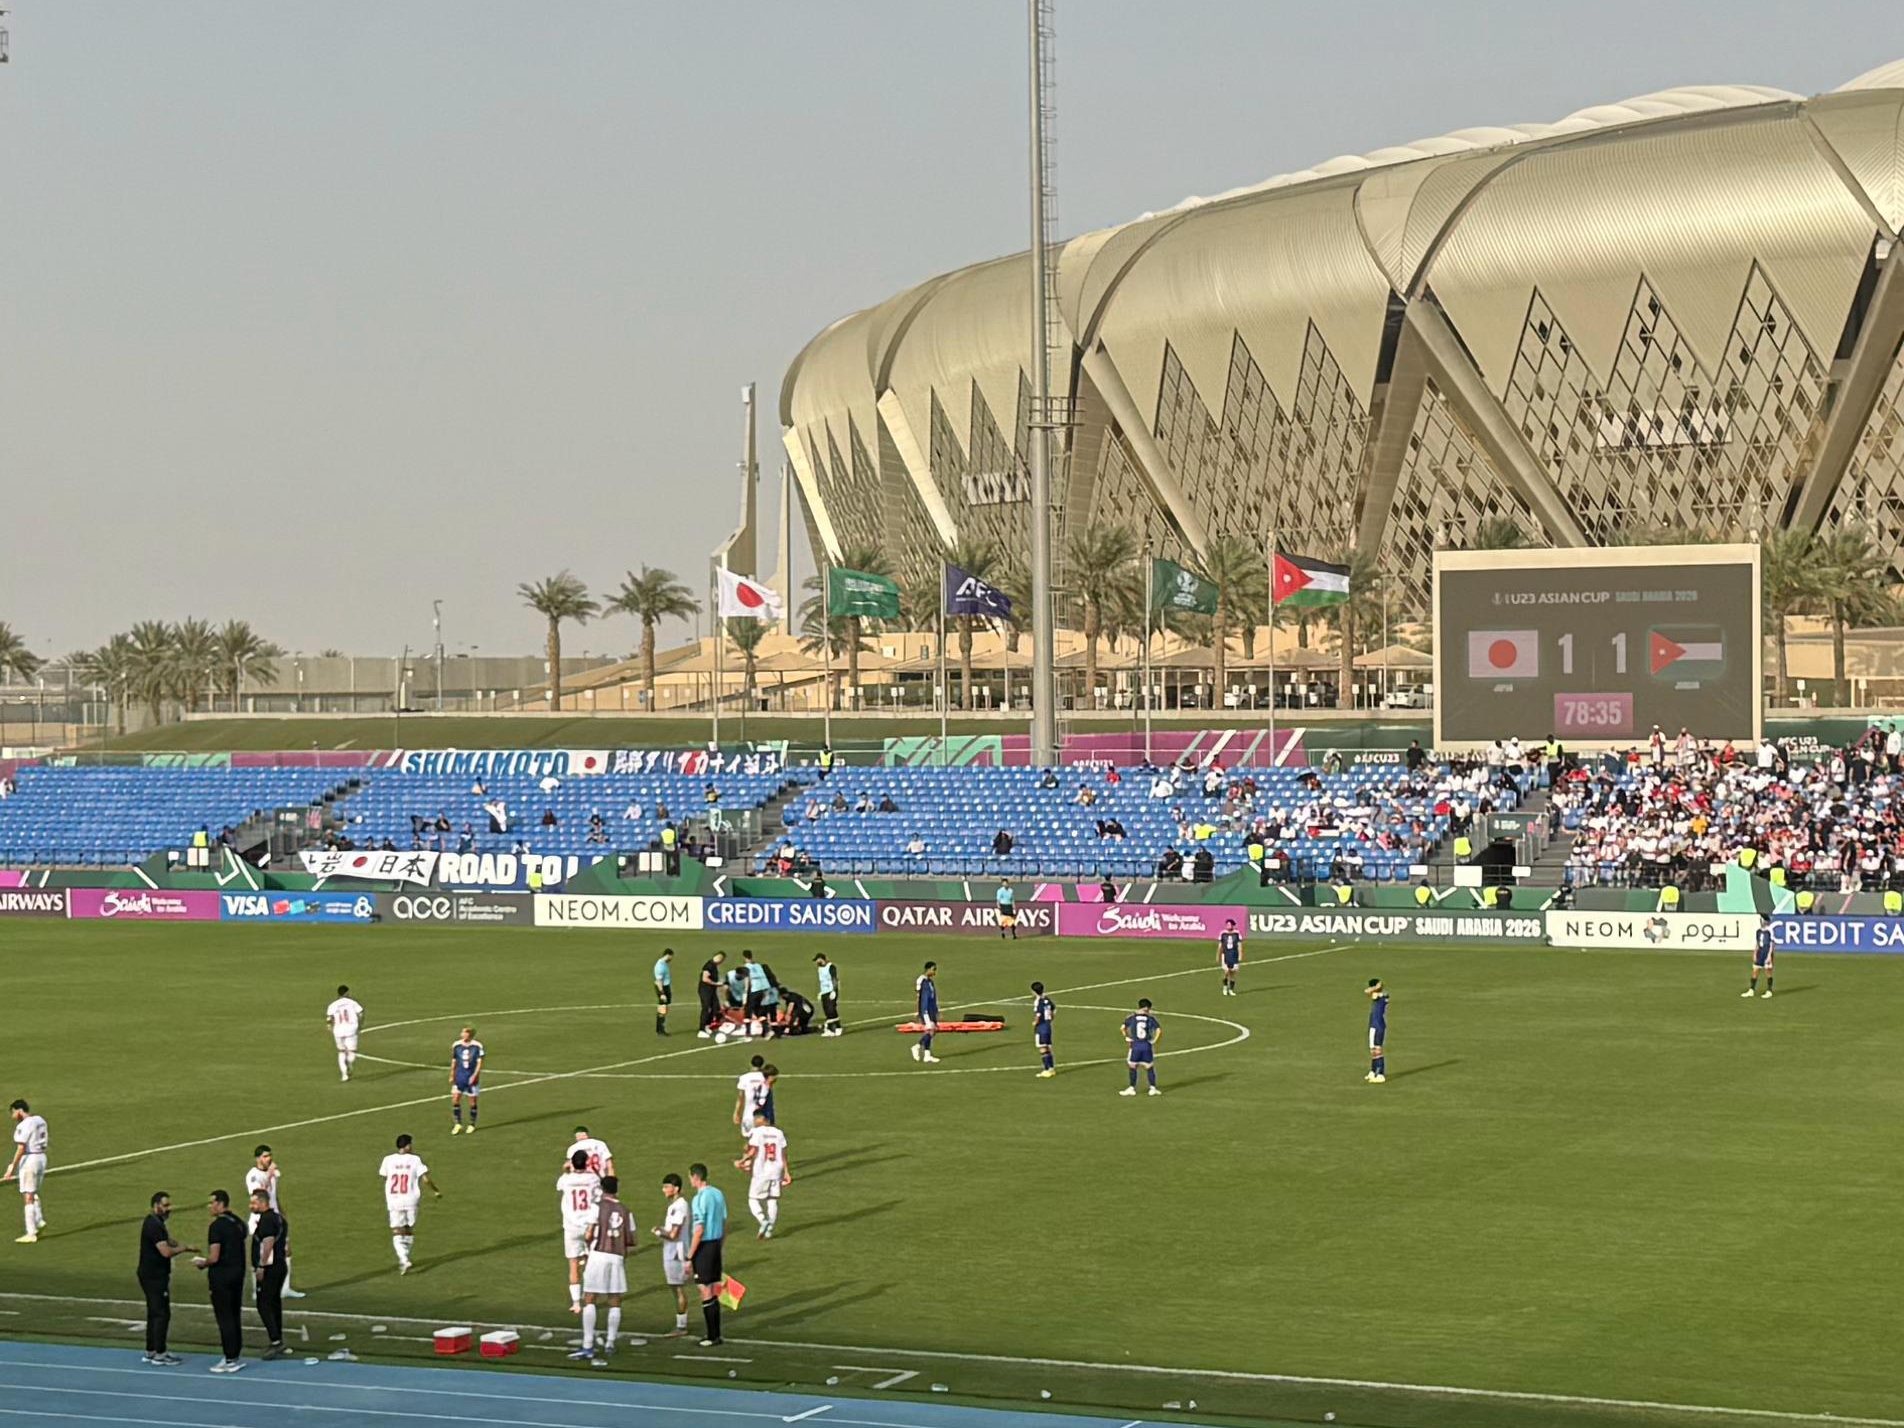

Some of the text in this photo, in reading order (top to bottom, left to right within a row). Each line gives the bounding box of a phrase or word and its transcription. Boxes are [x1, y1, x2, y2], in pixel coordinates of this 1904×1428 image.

[956, 577, 997, 606] AFC
[1511, 592, 1536, 605] U23
[1538, 592, 1580, 604] ASIAN
[1581, 591, 1610, 603] CUP
[1558, 632, 1627, 673] 1 1
[1564, 701, 1622, 725] 78:35
[406, 752, 569, 775] SHIMAMOTO
[379, 854, 425, 877] 日本
[438, 852, 517, 885] ROAD
[521, 855, 562, 885] TO
[223, 895, 269, 916] VISA
[393, 896, 451, 920] ace
[548, 899, 689, 923] NEOM.COM
[707, 902, 871, 926] CREDIT SAISON
[882, 906, 953, 927] QATAR
[1259, 914, 1298, 932] U23
[1299, 915, 1362, 934] ASIAN
[1364, 916, 1408, 935] CUP
[1415, 917, 1453, 936] SAUDI
[1456, 918, 1502, 937] ARABIA
[1505, 919, 1541, 938] 2026
[1566, 920, 1740, 943] NEOM نيوم
[1770, 921, 1865, 945] CREDIT
[1136, 1021, 1147, 1040] 6
[390, 1174, 409, 1194] 20
[571, 1189, 589, 1211] 13
